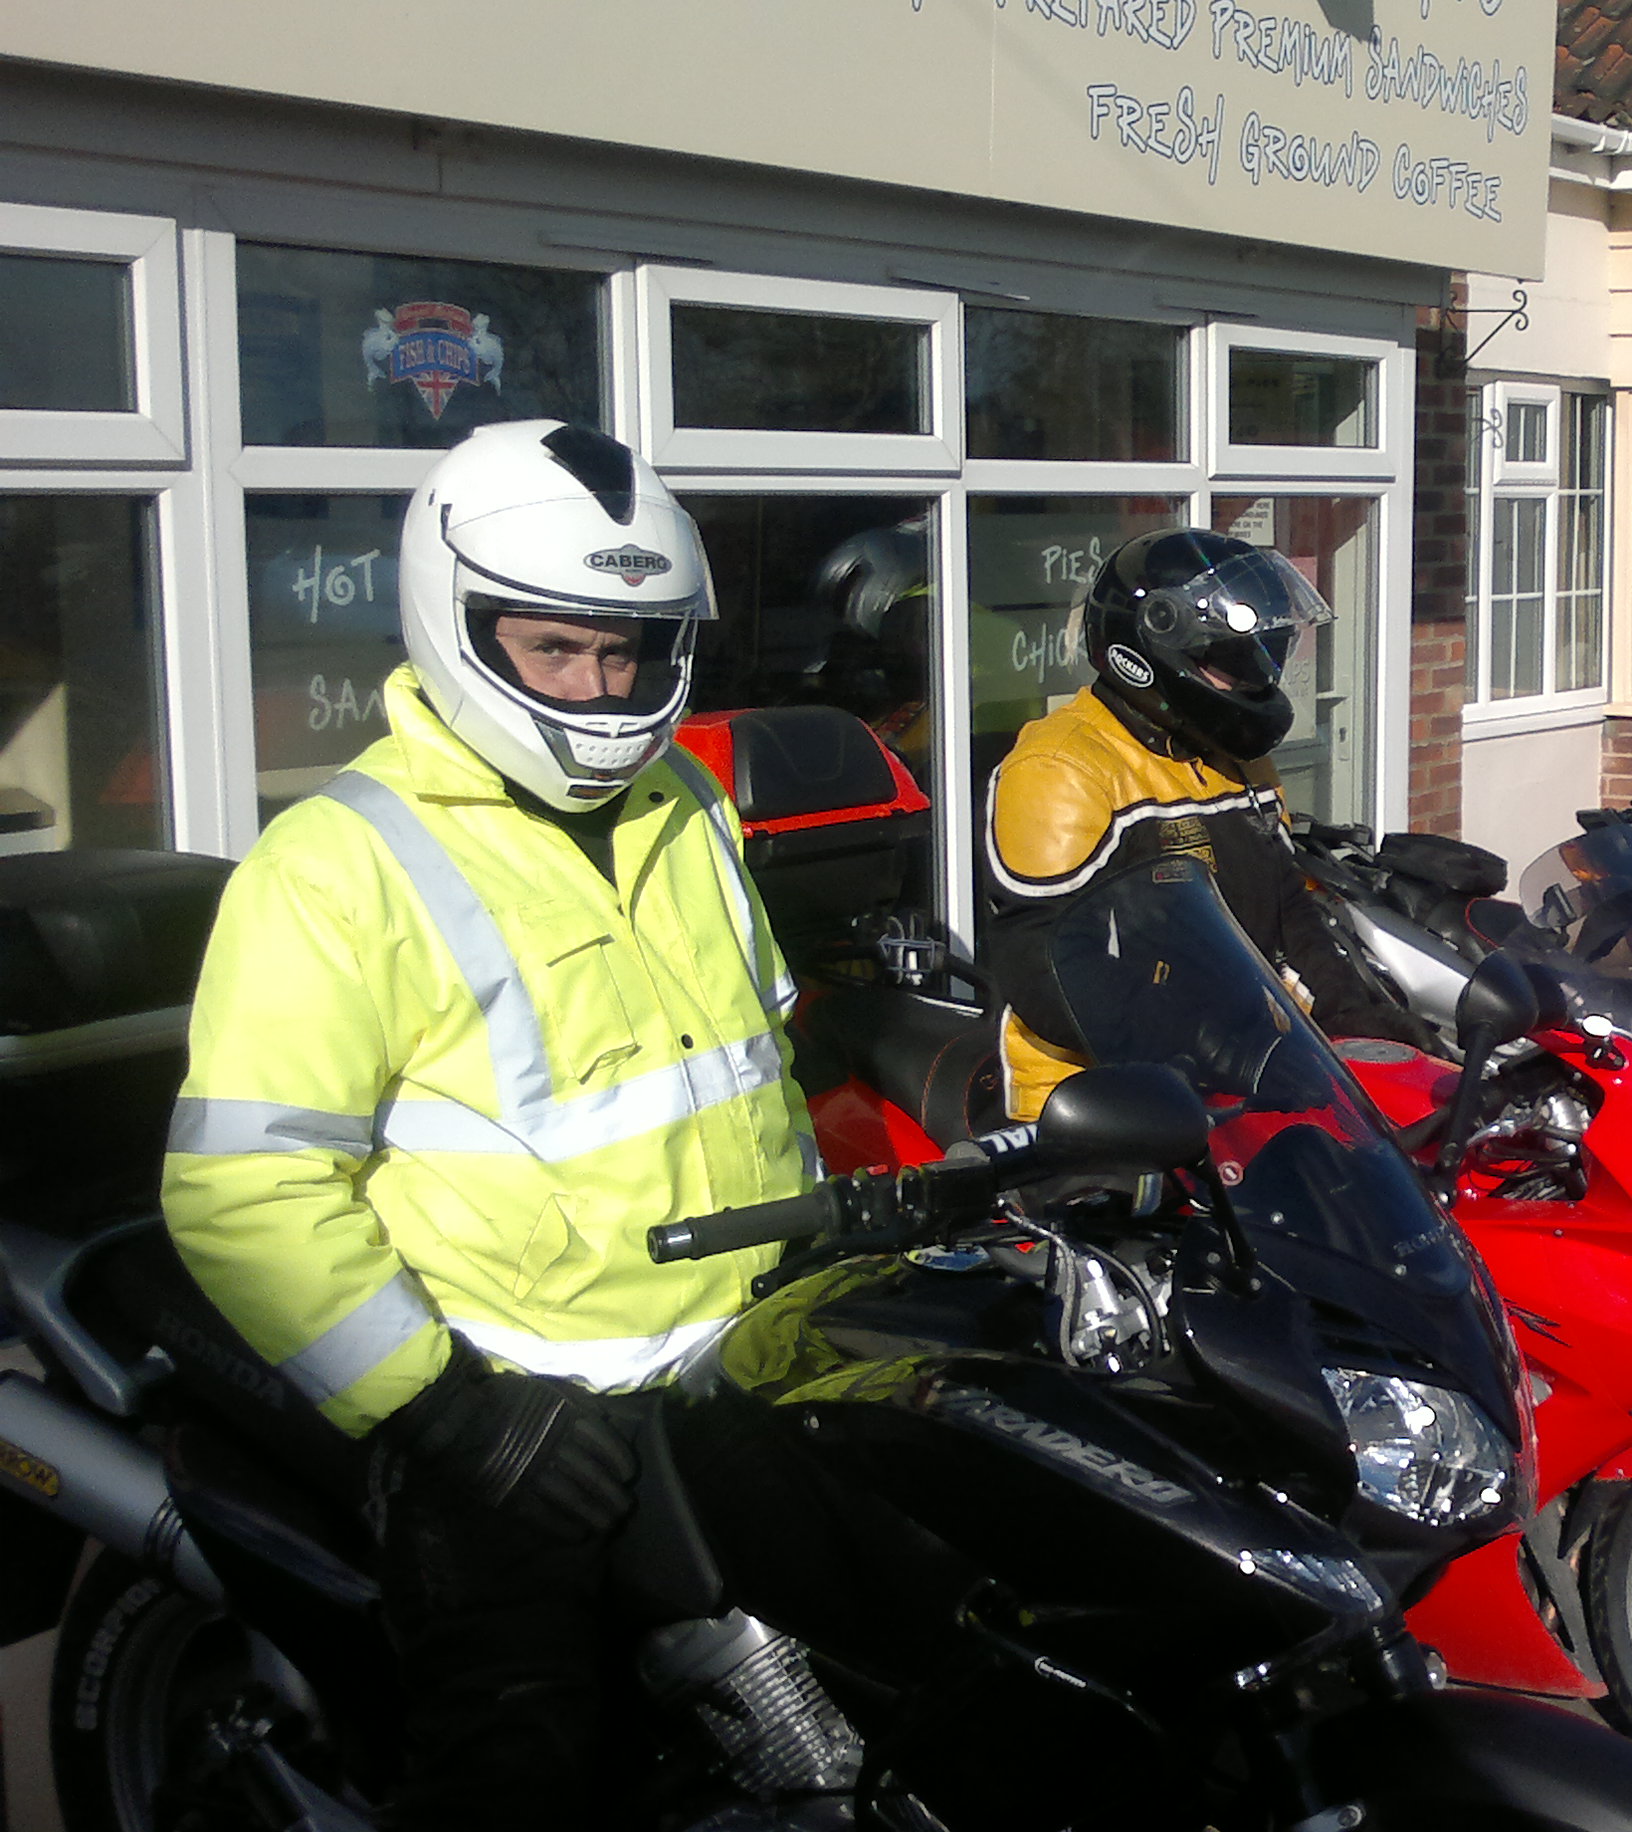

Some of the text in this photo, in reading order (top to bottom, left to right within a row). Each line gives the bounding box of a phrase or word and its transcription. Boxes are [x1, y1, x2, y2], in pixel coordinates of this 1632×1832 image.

[1365, 24, 1529, 143] SANDWICHES
[1086, 84, 1502, 223] FRESH GROUND COFFEE
[400, 338, 426, 371] FISH
[438, 339, 471, 375] CHIPS
[292, 545, 381, 624] HOT
[1042, 536, 1104, 585] PIES
